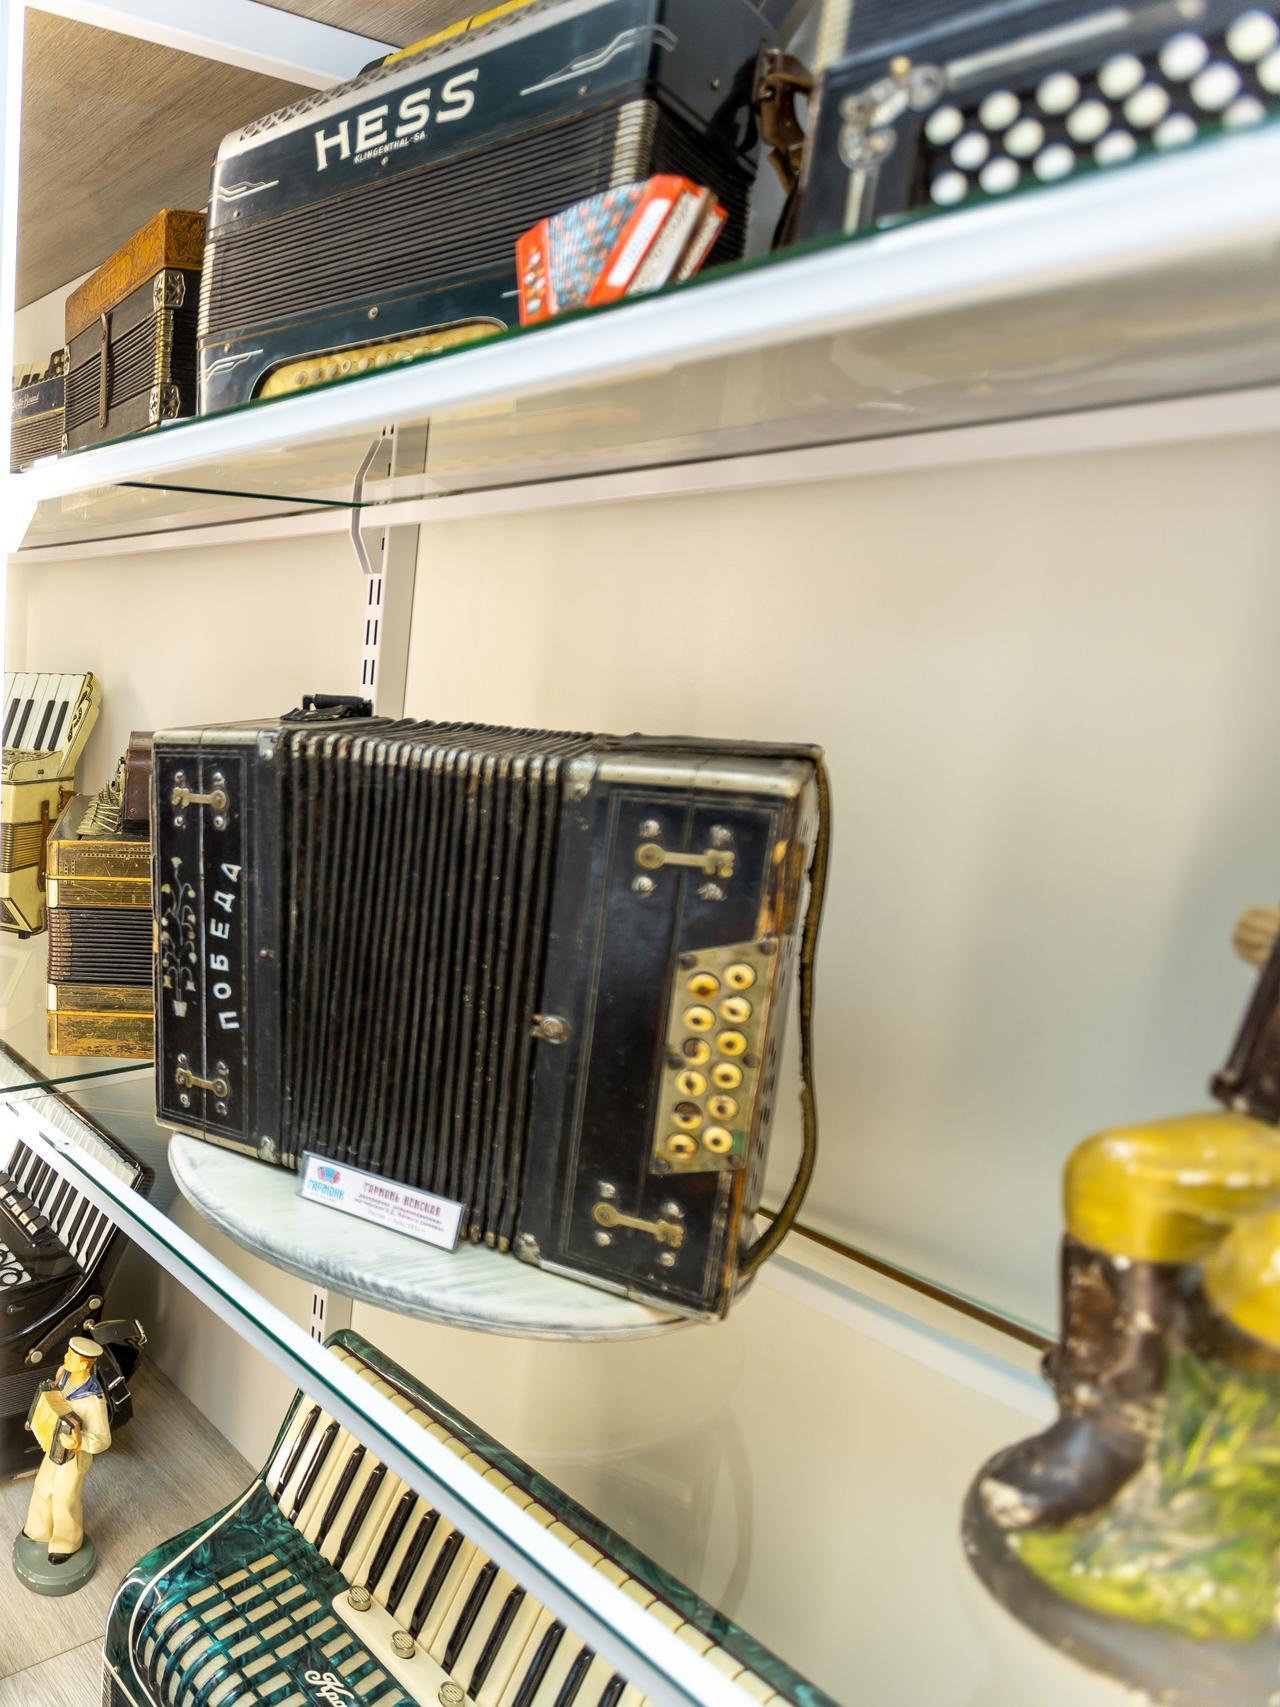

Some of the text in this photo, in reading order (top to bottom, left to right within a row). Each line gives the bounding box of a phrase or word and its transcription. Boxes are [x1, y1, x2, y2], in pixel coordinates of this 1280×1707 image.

[314, 68, 480, 172] HESS
[209, 862, 243, 1031] ПОБЕДА
[363, 1182, 400, 1203] ГАРМОНЬ
[404, 1195, 442, 1217] ВЕНСКАЯ
